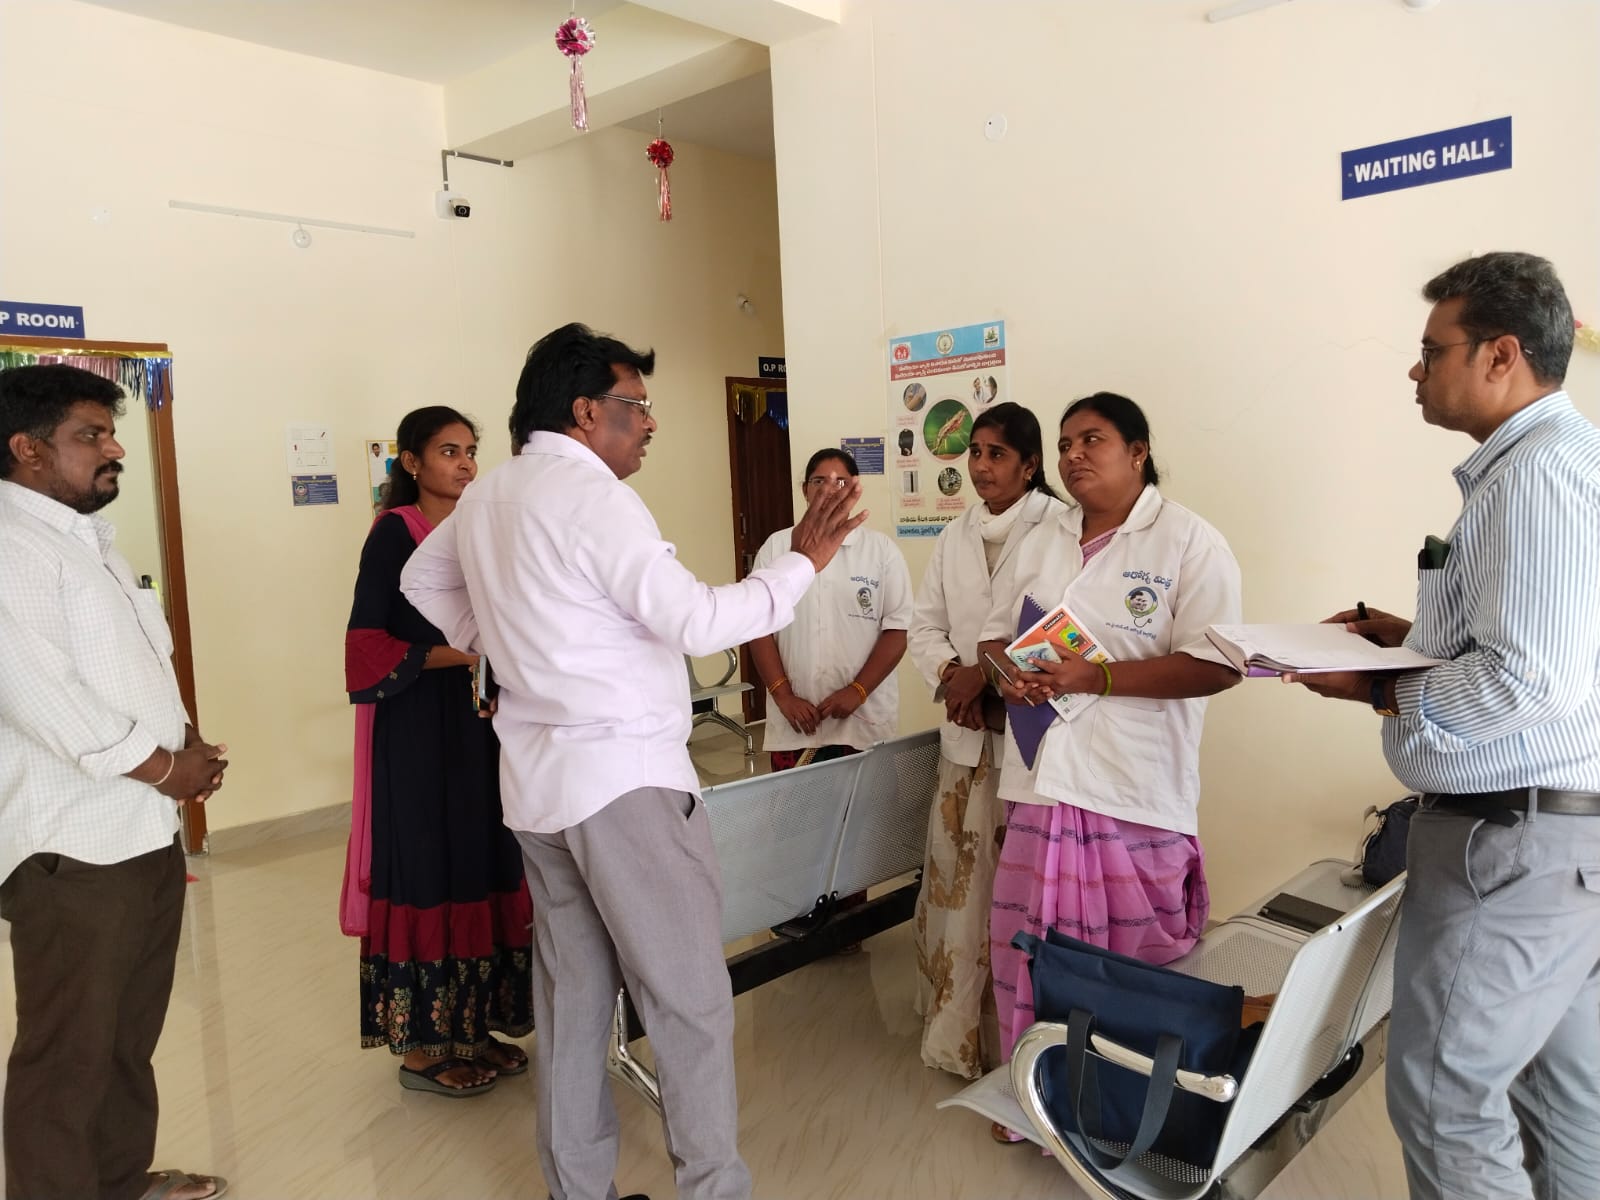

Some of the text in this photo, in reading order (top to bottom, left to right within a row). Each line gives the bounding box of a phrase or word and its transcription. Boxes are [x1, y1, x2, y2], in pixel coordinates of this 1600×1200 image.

[1354, 138, 1495, 183] WAITING HALL
[16, 312, 75, 329] ROOM
[763, 363, 776, 372] O.P
